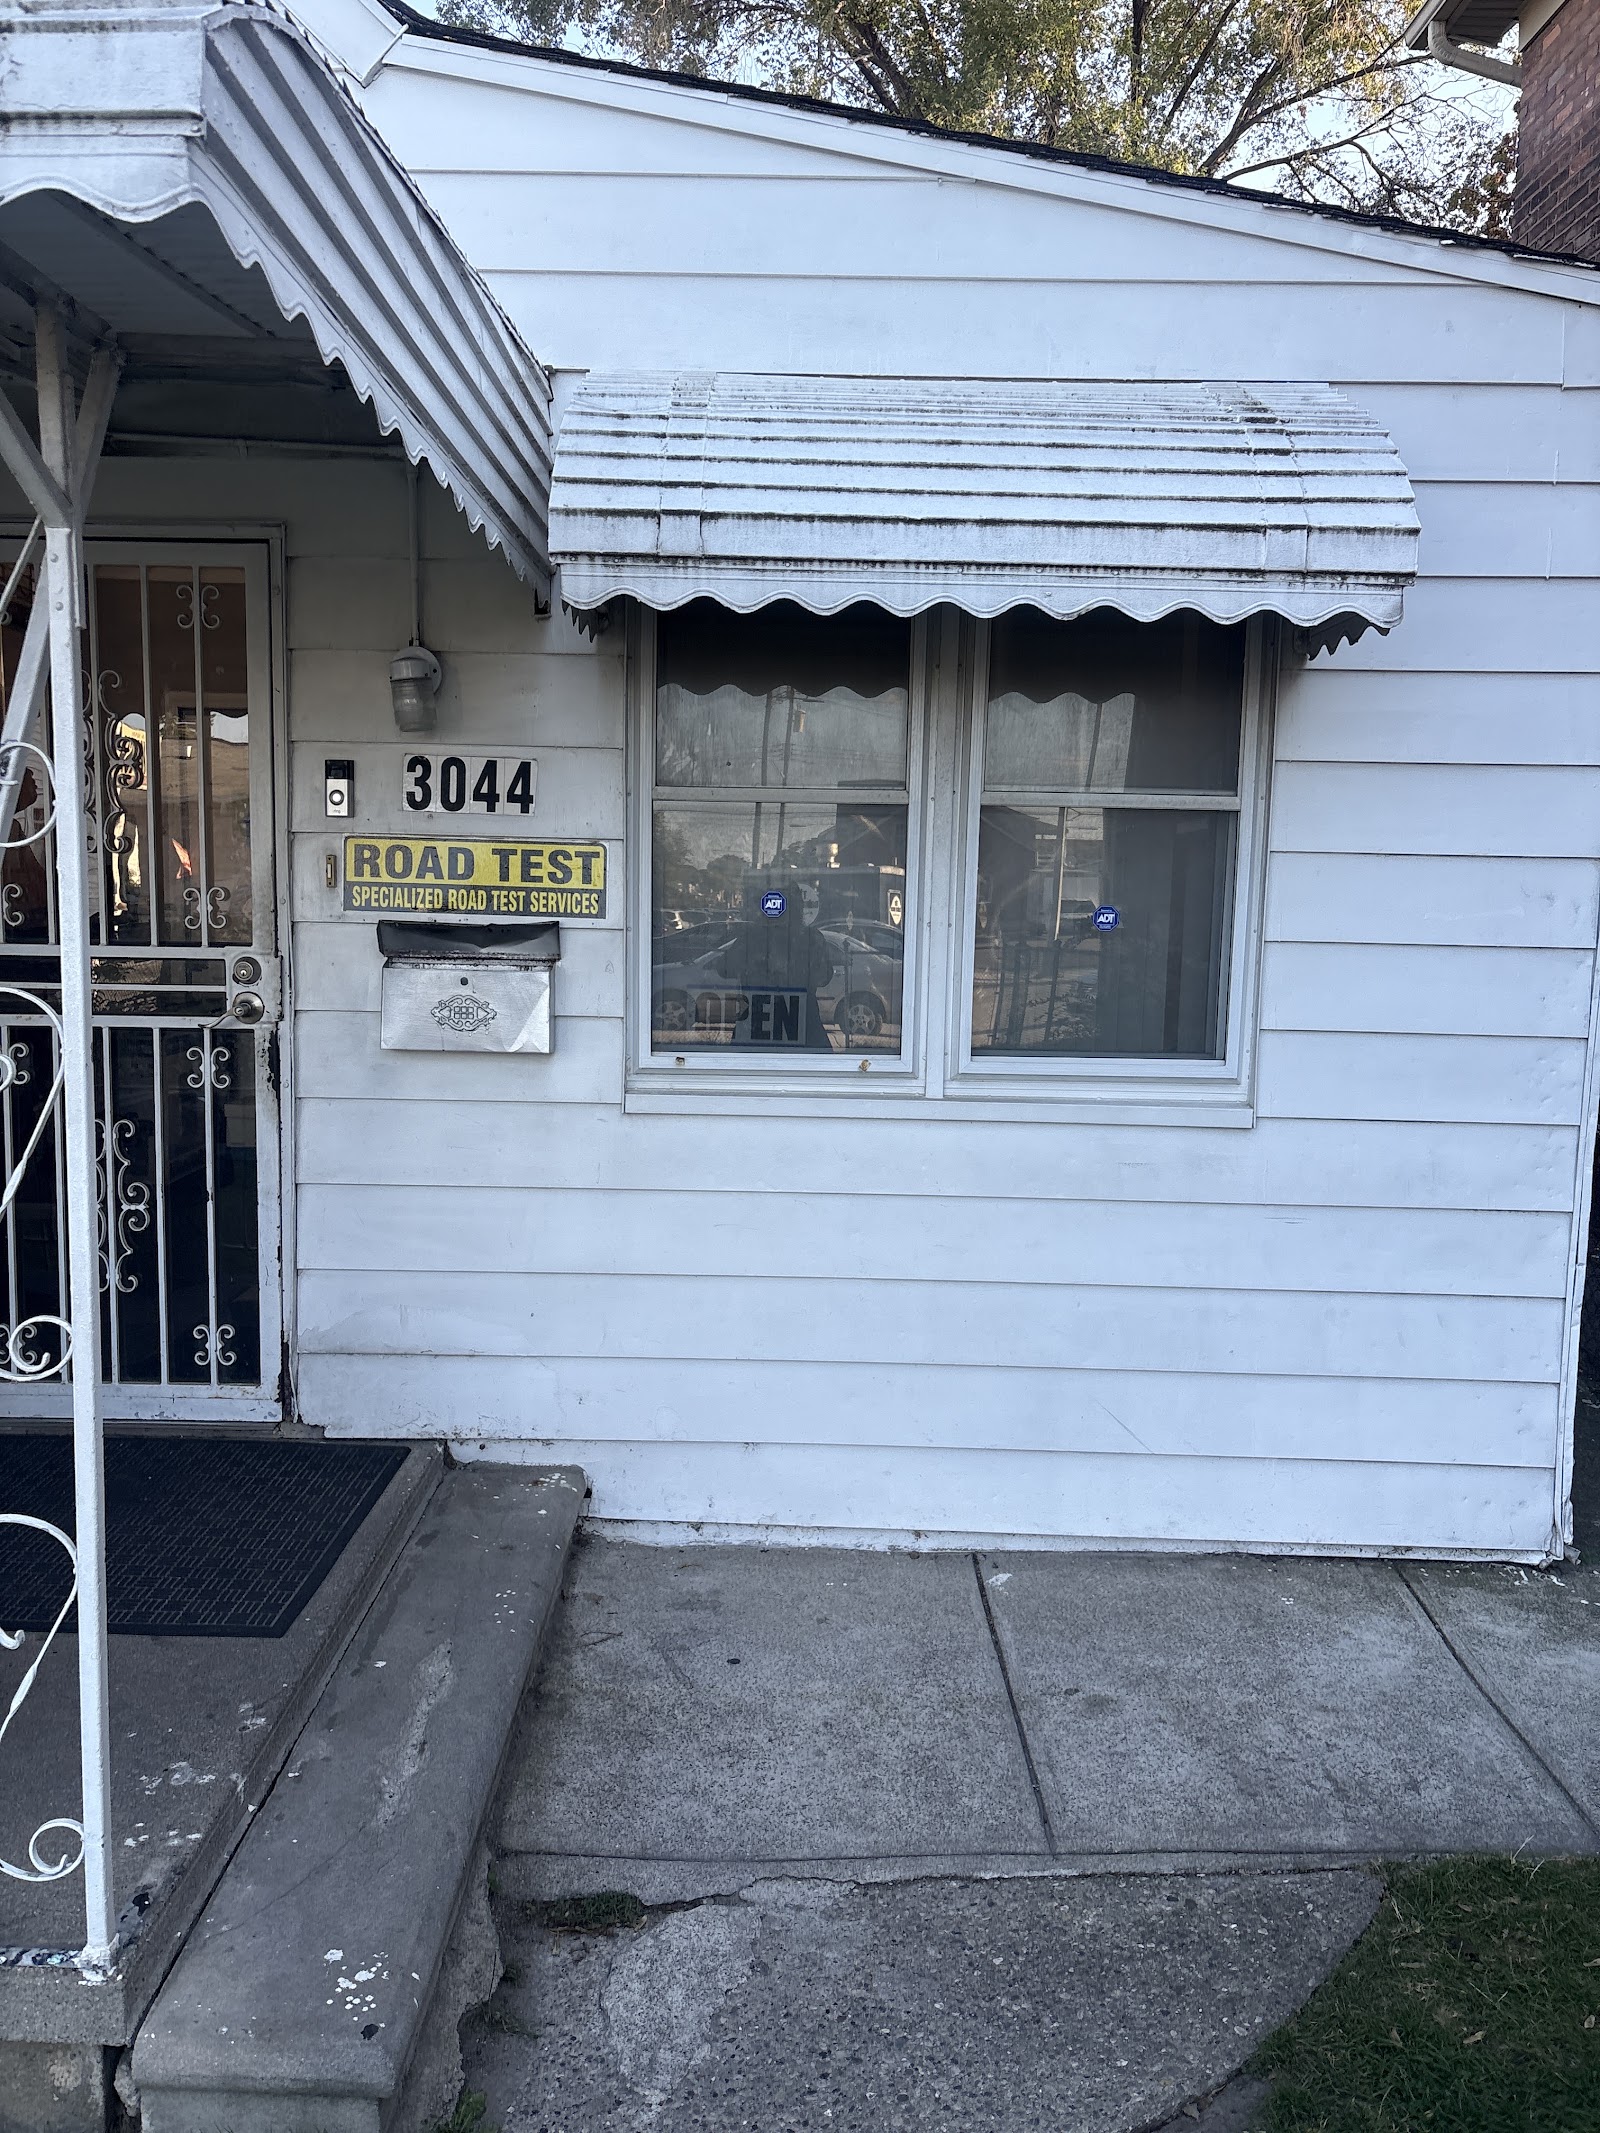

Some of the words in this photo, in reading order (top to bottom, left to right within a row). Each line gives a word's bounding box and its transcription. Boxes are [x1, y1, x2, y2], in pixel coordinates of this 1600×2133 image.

[406, 756, 534, 814] 3044
[353, 843, 475, 880] ROAD
[492, 849, 600, 885] TEST
[352, 885, 443, 910] SPECIALIZED
[447, 890, 487, 912] ROAD
[491, 891, 526, 914] TEST
[530, 891, 600, 915] SERVICES
[765, 899, 782, 909] ADT
[1097, 914, 1115, 923] ADT
[695, 991, 800, 1041] OPEN
